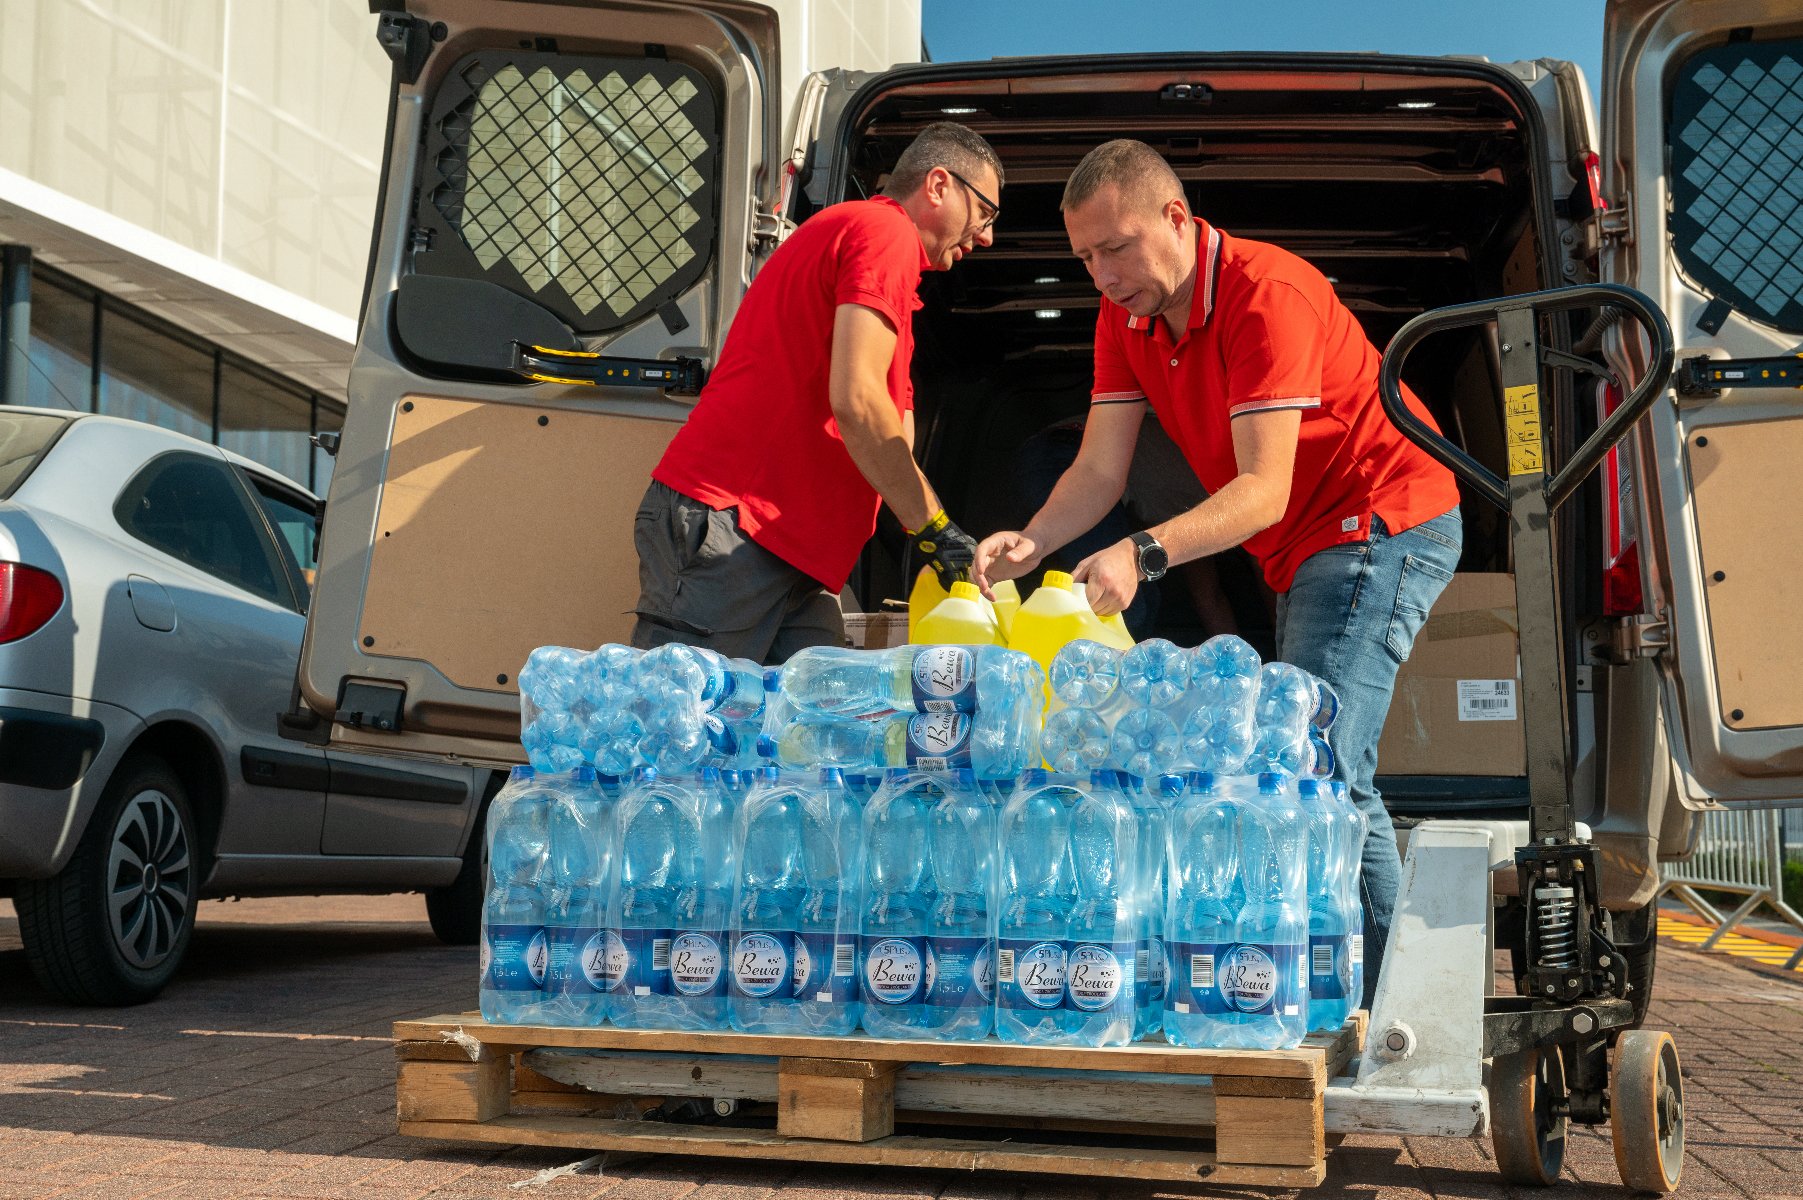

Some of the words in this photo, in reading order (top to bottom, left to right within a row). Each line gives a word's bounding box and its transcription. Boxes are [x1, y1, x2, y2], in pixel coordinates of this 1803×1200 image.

[932, 650, 956, 692] Bewa
[673, 951, 715, 975] Bewa
[738, 952, 781, 975] Bewa
[873, 958, 917, 982] Bewa
[1070, 964, 1114, 989] Bewa
[1234, 965, 1271, 991] Bewa
